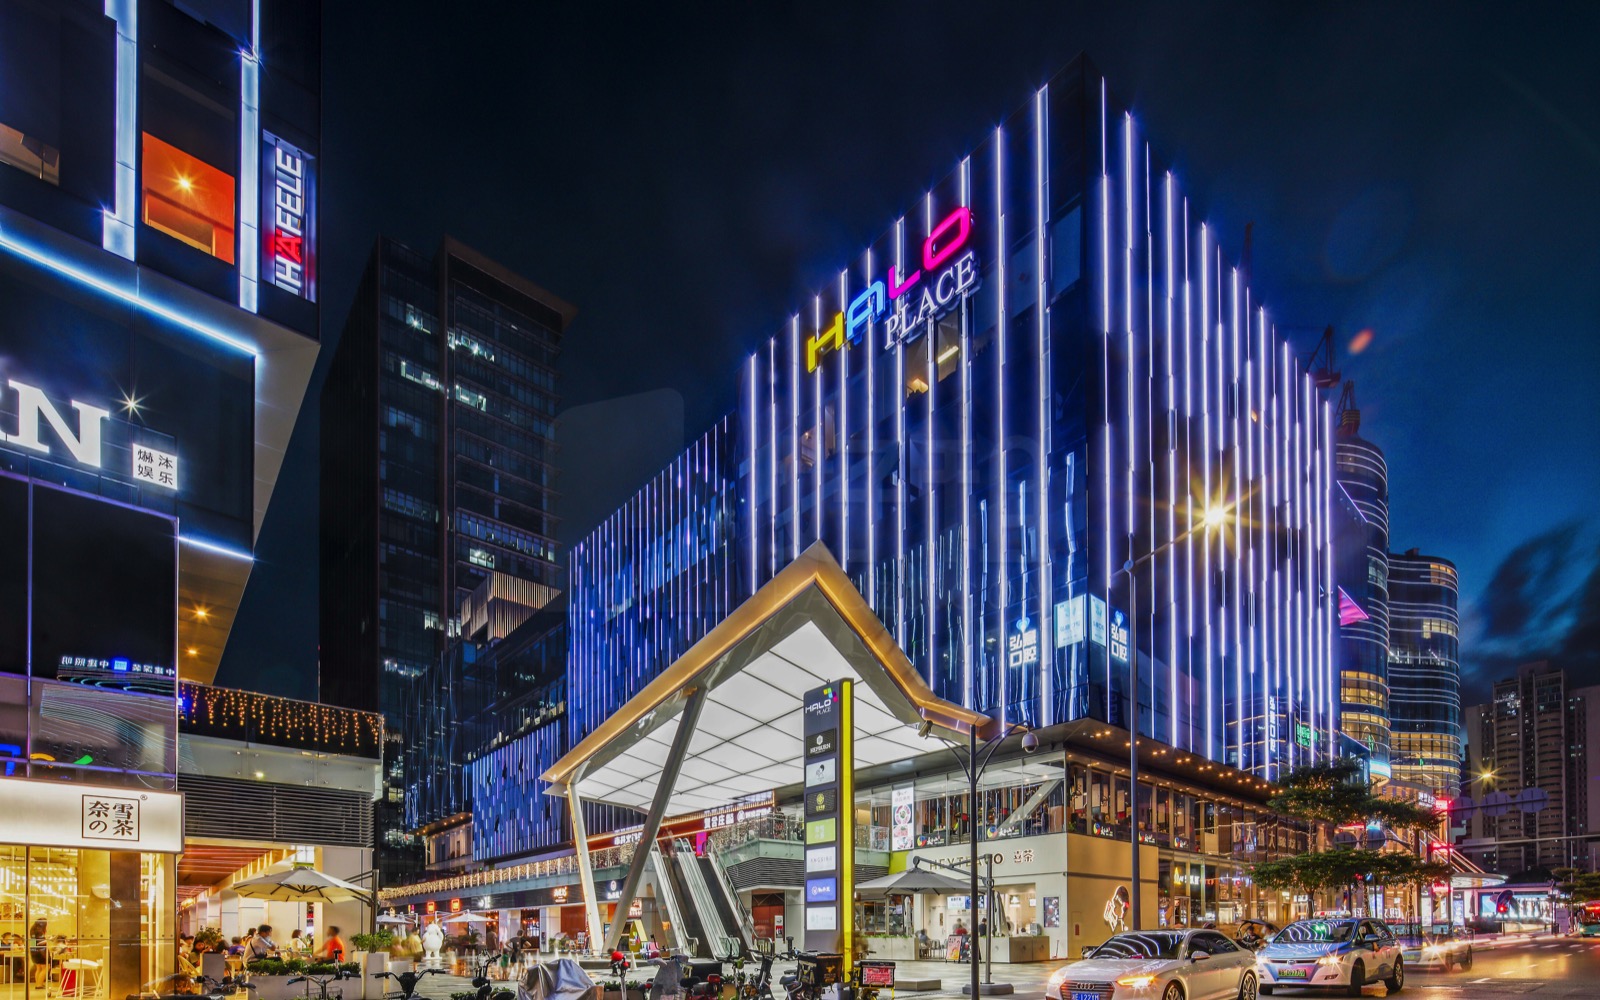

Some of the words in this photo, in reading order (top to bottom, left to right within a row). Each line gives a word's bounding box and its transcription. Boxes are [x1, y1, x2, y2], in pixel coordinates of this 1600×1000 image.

[807, 206, 972, 374] HALO
[884, 250, 976, 351] PLACE
[0, 379, 111, 469] N
[137, 463, 174, 486] 娱乐
[805, 698, 832, 714] HALO
[816, 706, 832, 716] PLACE
[87, 800, 135, 819] 奈雪
[87, 818, 135, 837] の茶
[1013, 849, 1035, 864] 喜茶
